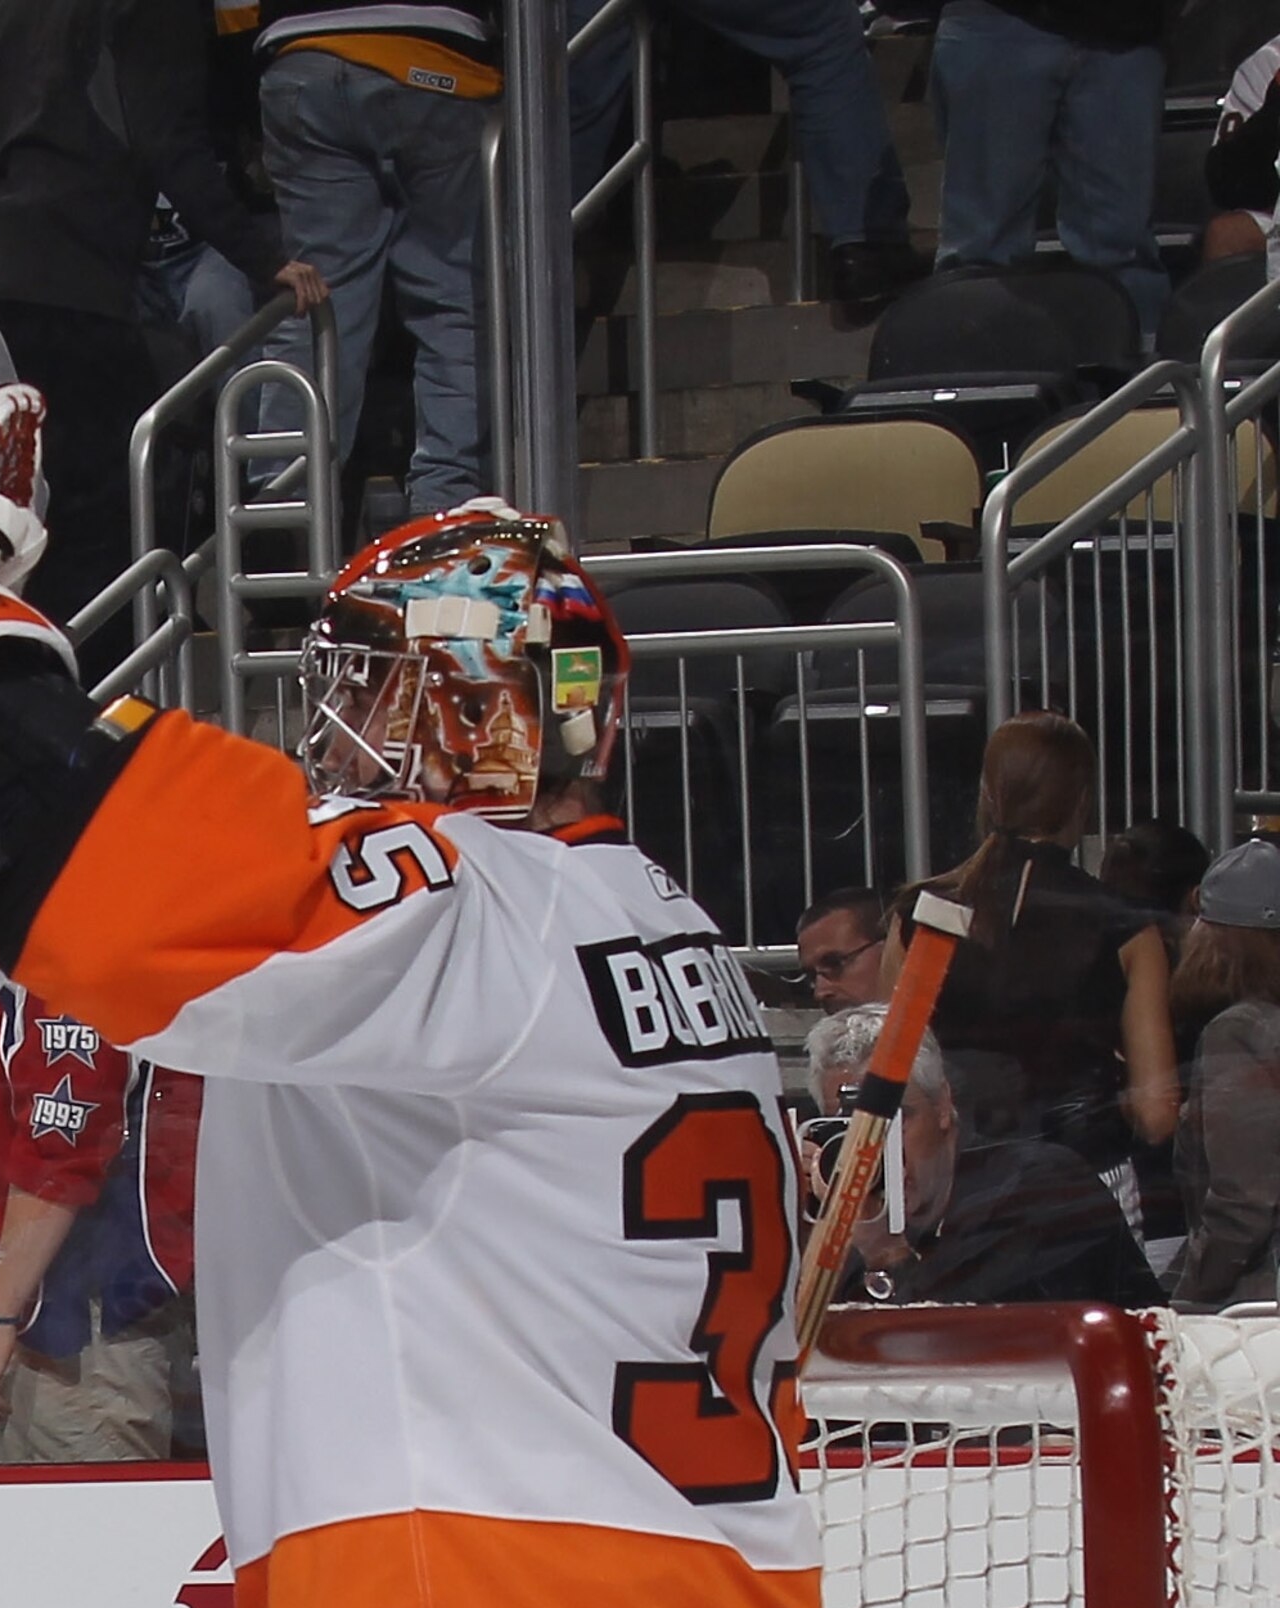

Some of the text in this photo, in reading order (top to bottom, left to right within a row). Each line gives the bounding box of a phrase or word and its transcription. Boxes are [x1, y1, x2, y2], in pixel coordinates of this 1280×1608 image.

[44, 1024, 96, 1051] 1975
[33, 1099, 85, 1130] 1993
[816, 1139, 884, 1272] Reebok
[611, 1090, 800, 1506] 3
